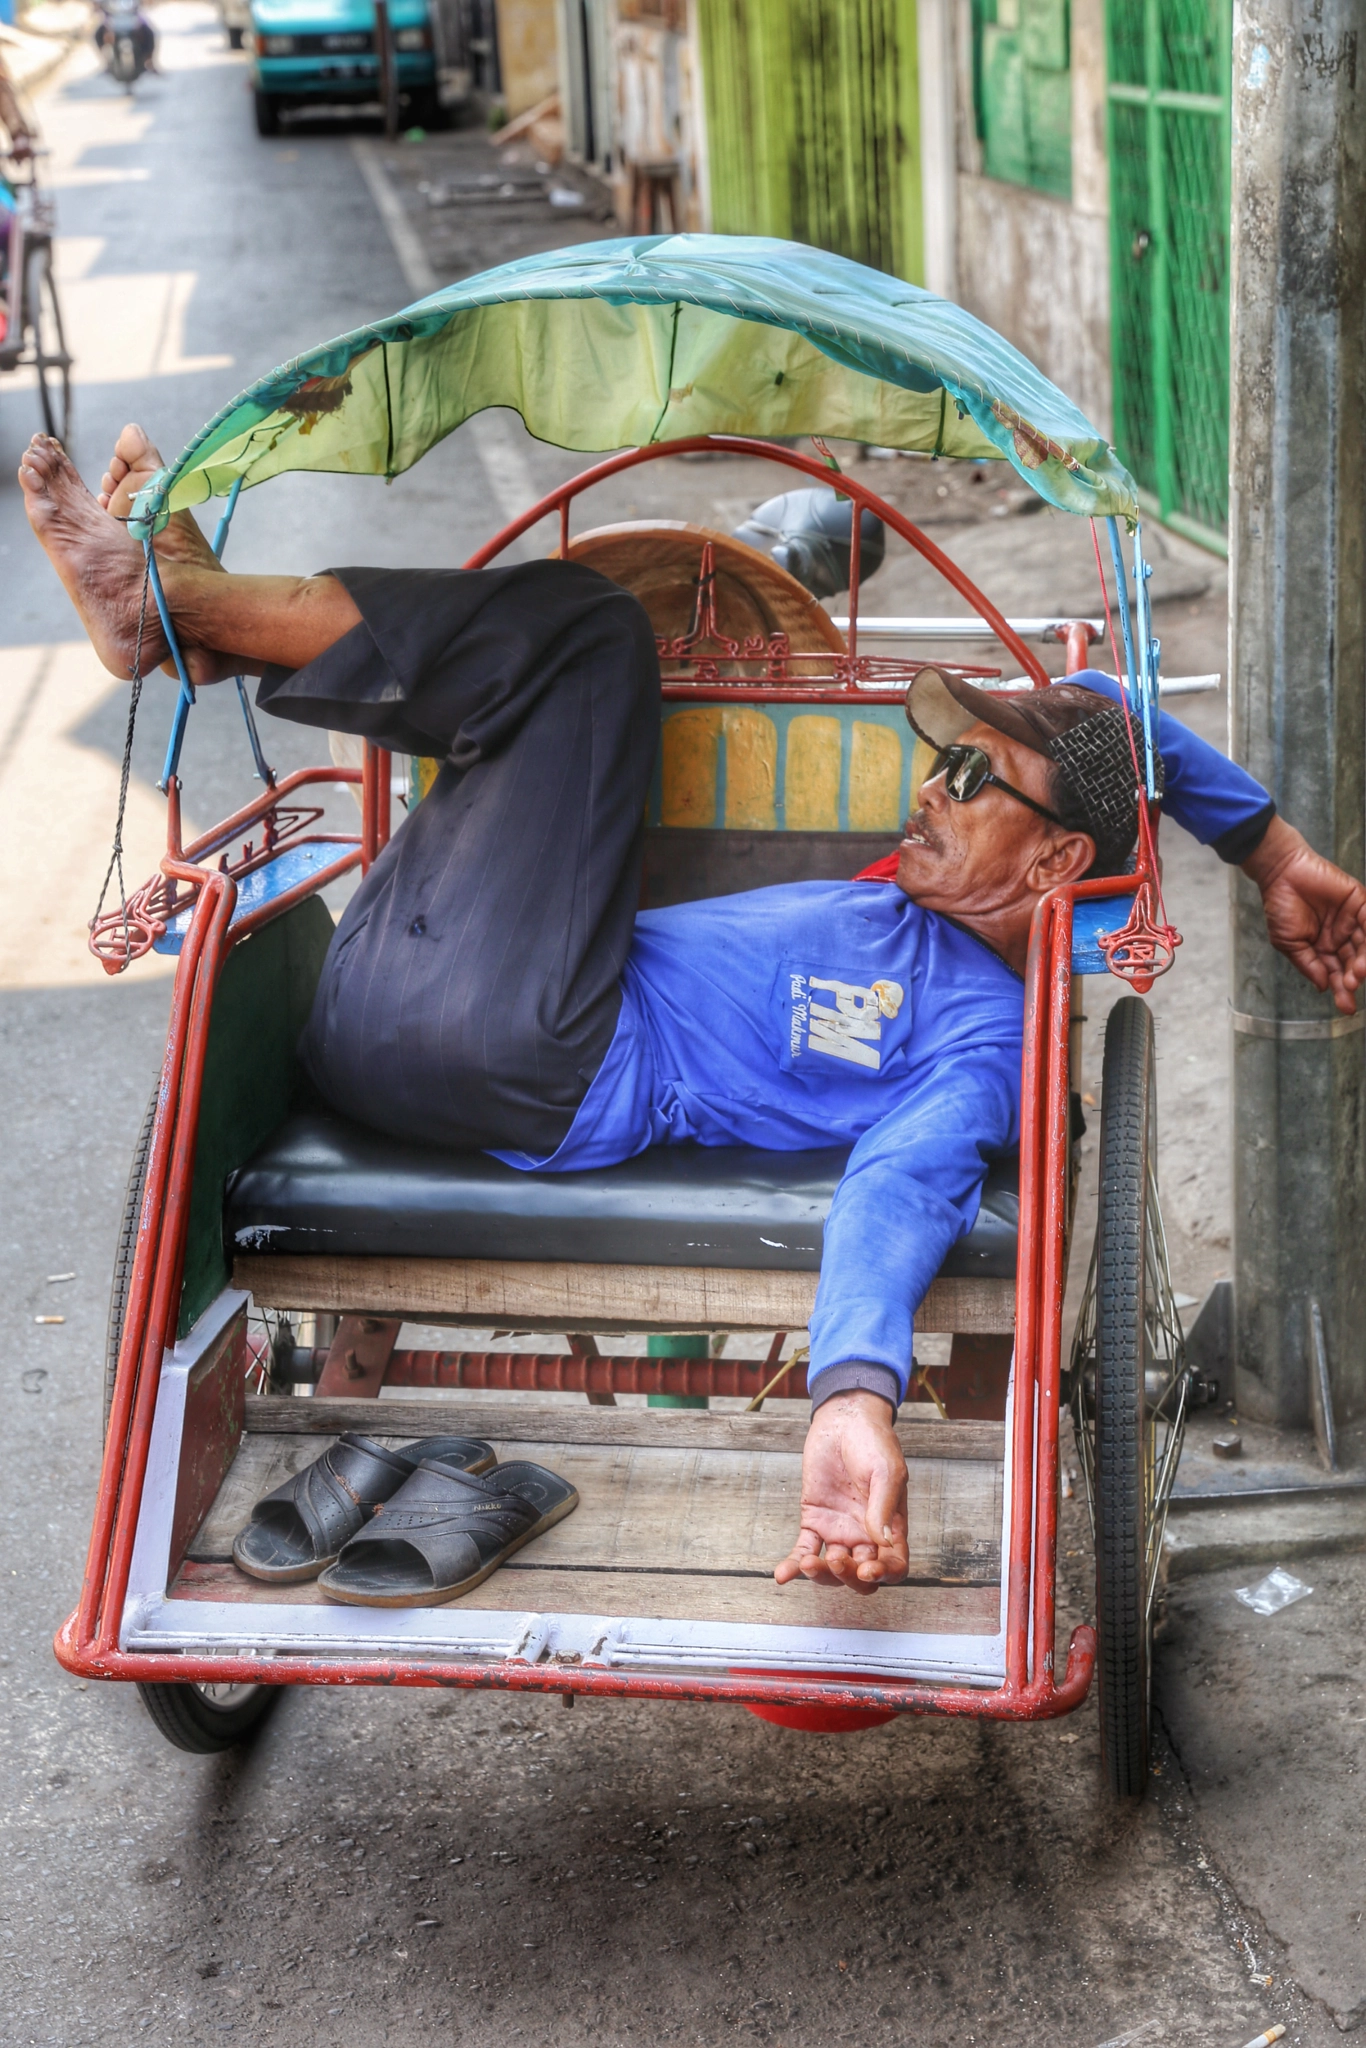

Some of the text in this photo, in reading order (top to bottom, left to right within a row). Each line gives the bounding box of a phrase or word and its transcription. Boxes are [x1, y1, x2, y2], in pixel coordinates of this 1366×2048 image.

[790, 973, 808, 1059] Padi Makmur
[809, 976, 881, 1070] PM
